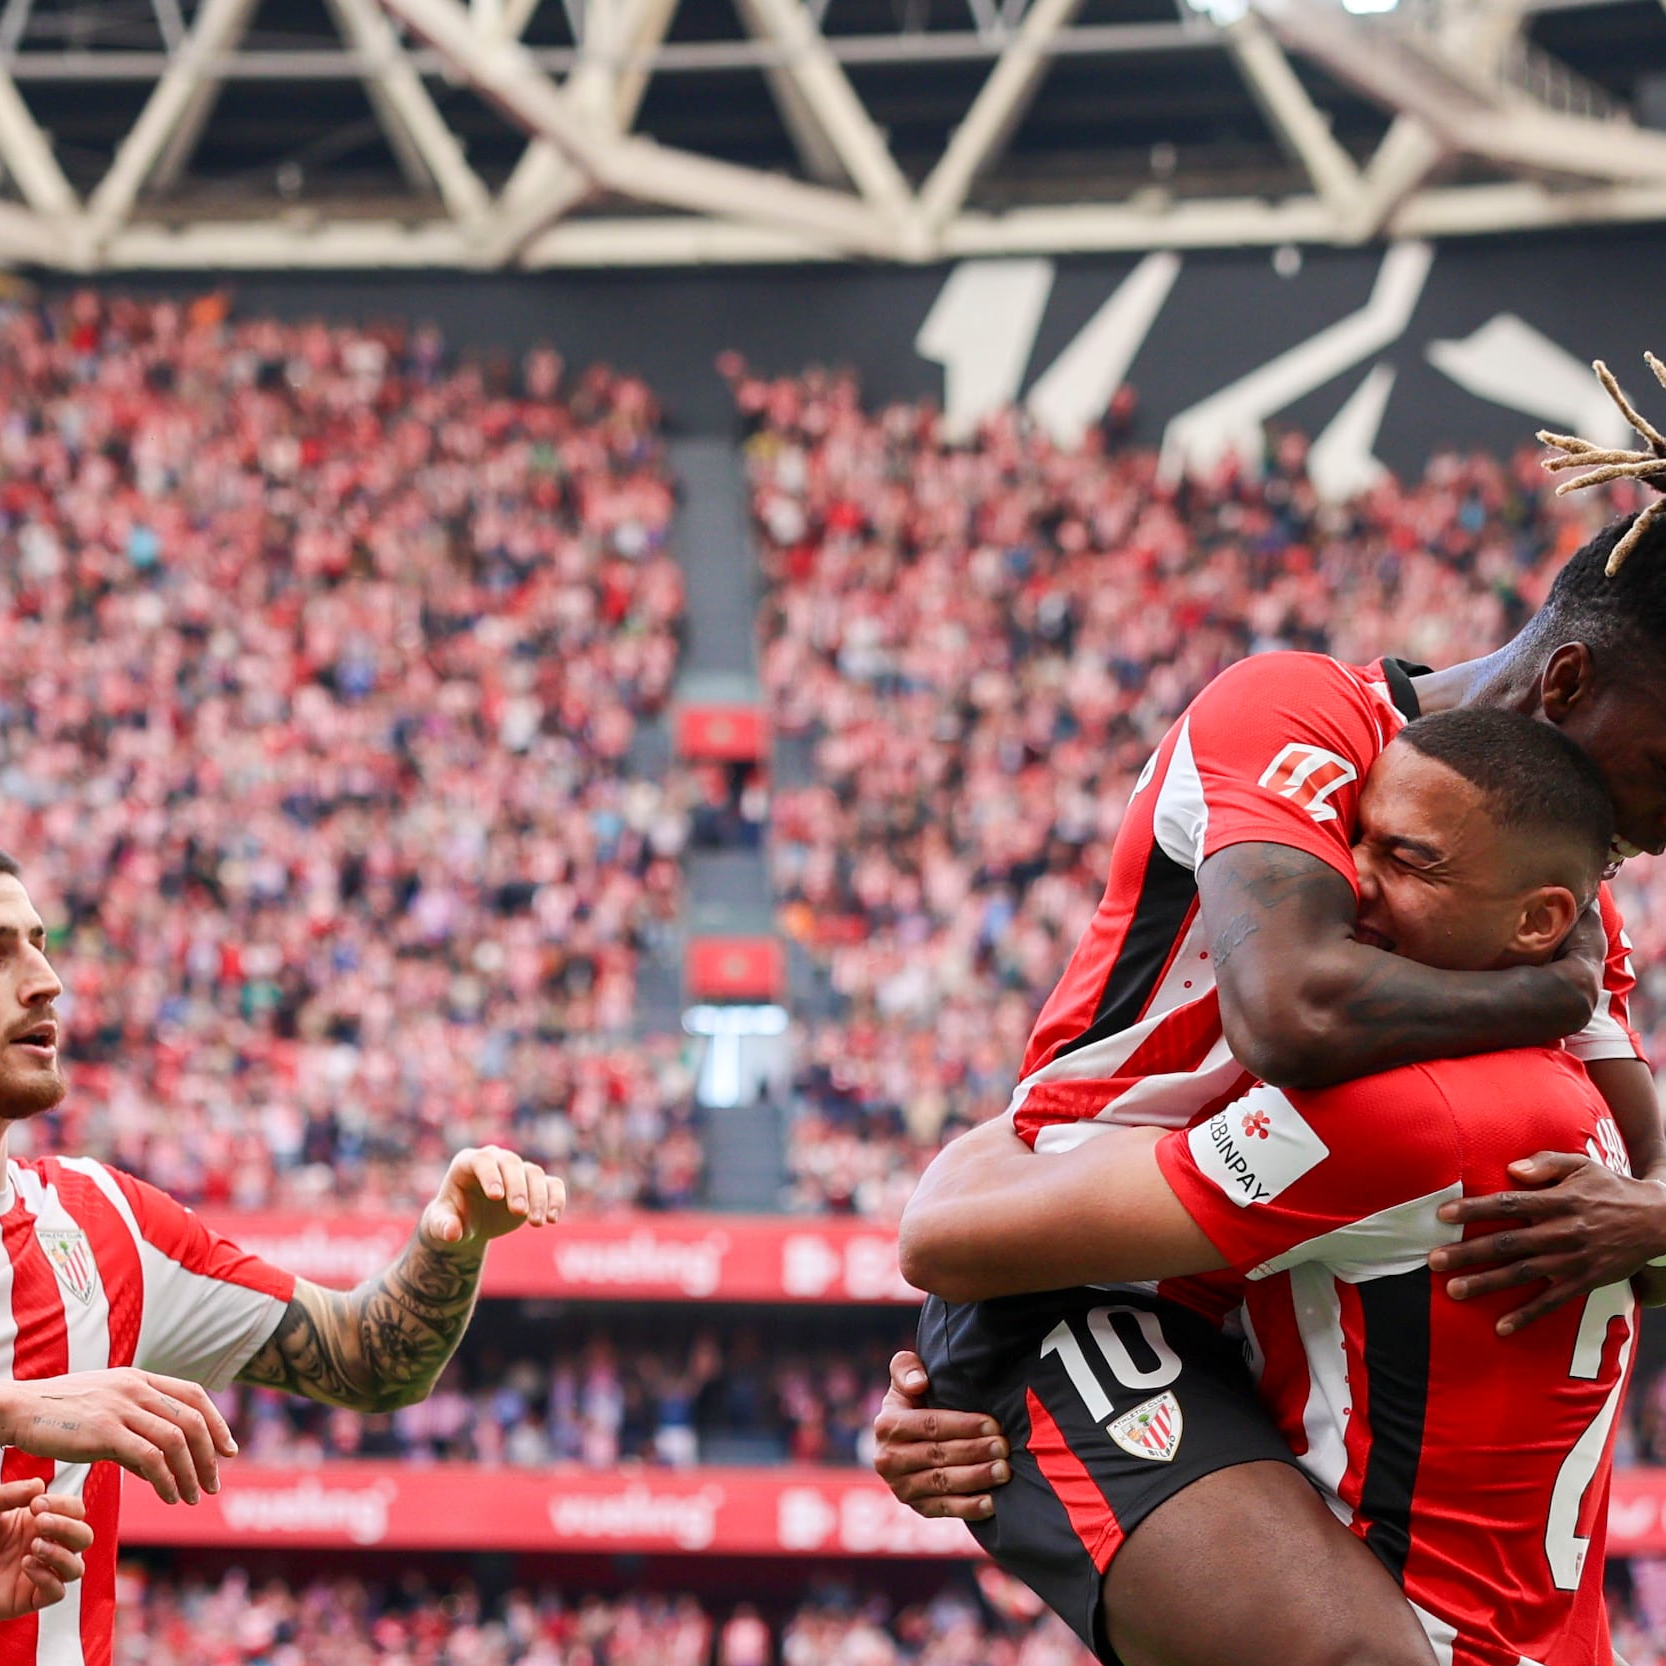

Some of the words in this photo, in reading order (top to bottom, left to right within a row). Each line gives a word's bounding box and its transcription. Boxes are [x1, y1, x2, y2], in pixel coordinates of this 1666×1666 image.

[1040, 1305, 1182, 1423] 10
[1113, 1406, 1147, 1429] ATHLETIC
[1147, 1395, 1168, 1408] CLUB
